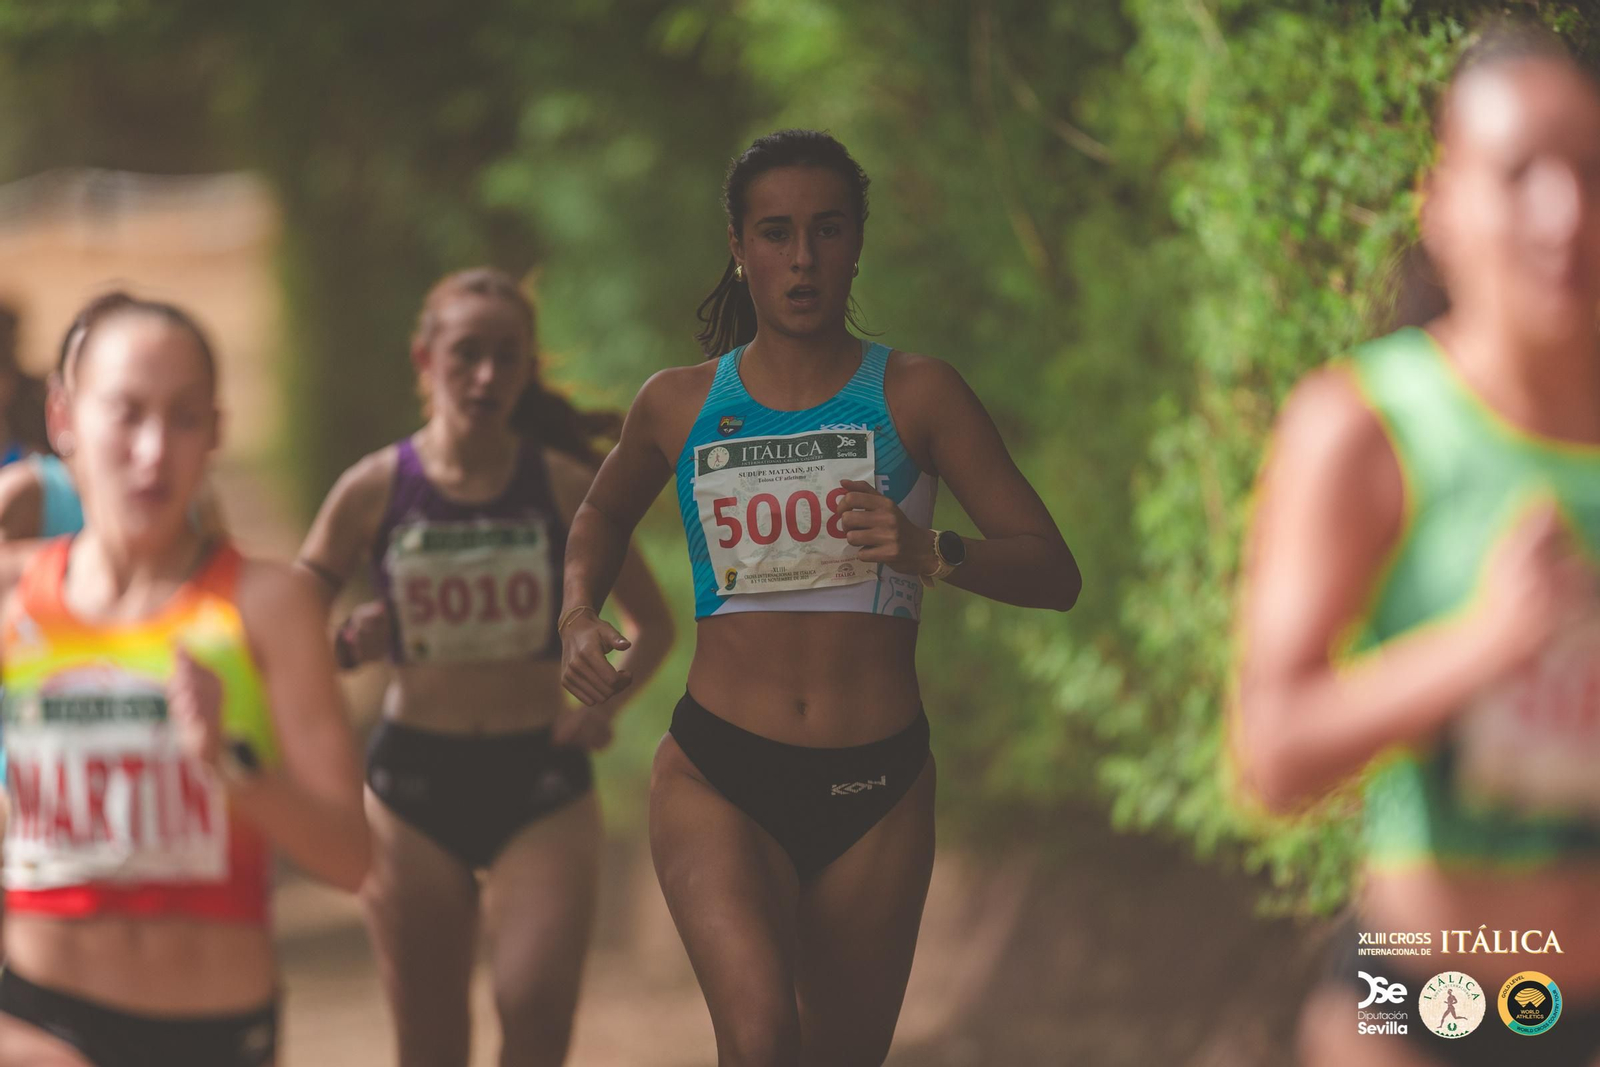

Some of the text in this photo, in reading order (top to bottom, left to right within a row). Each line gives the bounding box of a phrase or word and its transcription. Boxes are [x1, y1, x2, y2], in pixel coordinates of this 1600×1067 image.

[741, 440, 823, 462] ITÁLICA
[738, 470, 767, 478] SUDUPE
[806, 465, 826, 473] JUNE
[405, 570, 541, 627] 5010
